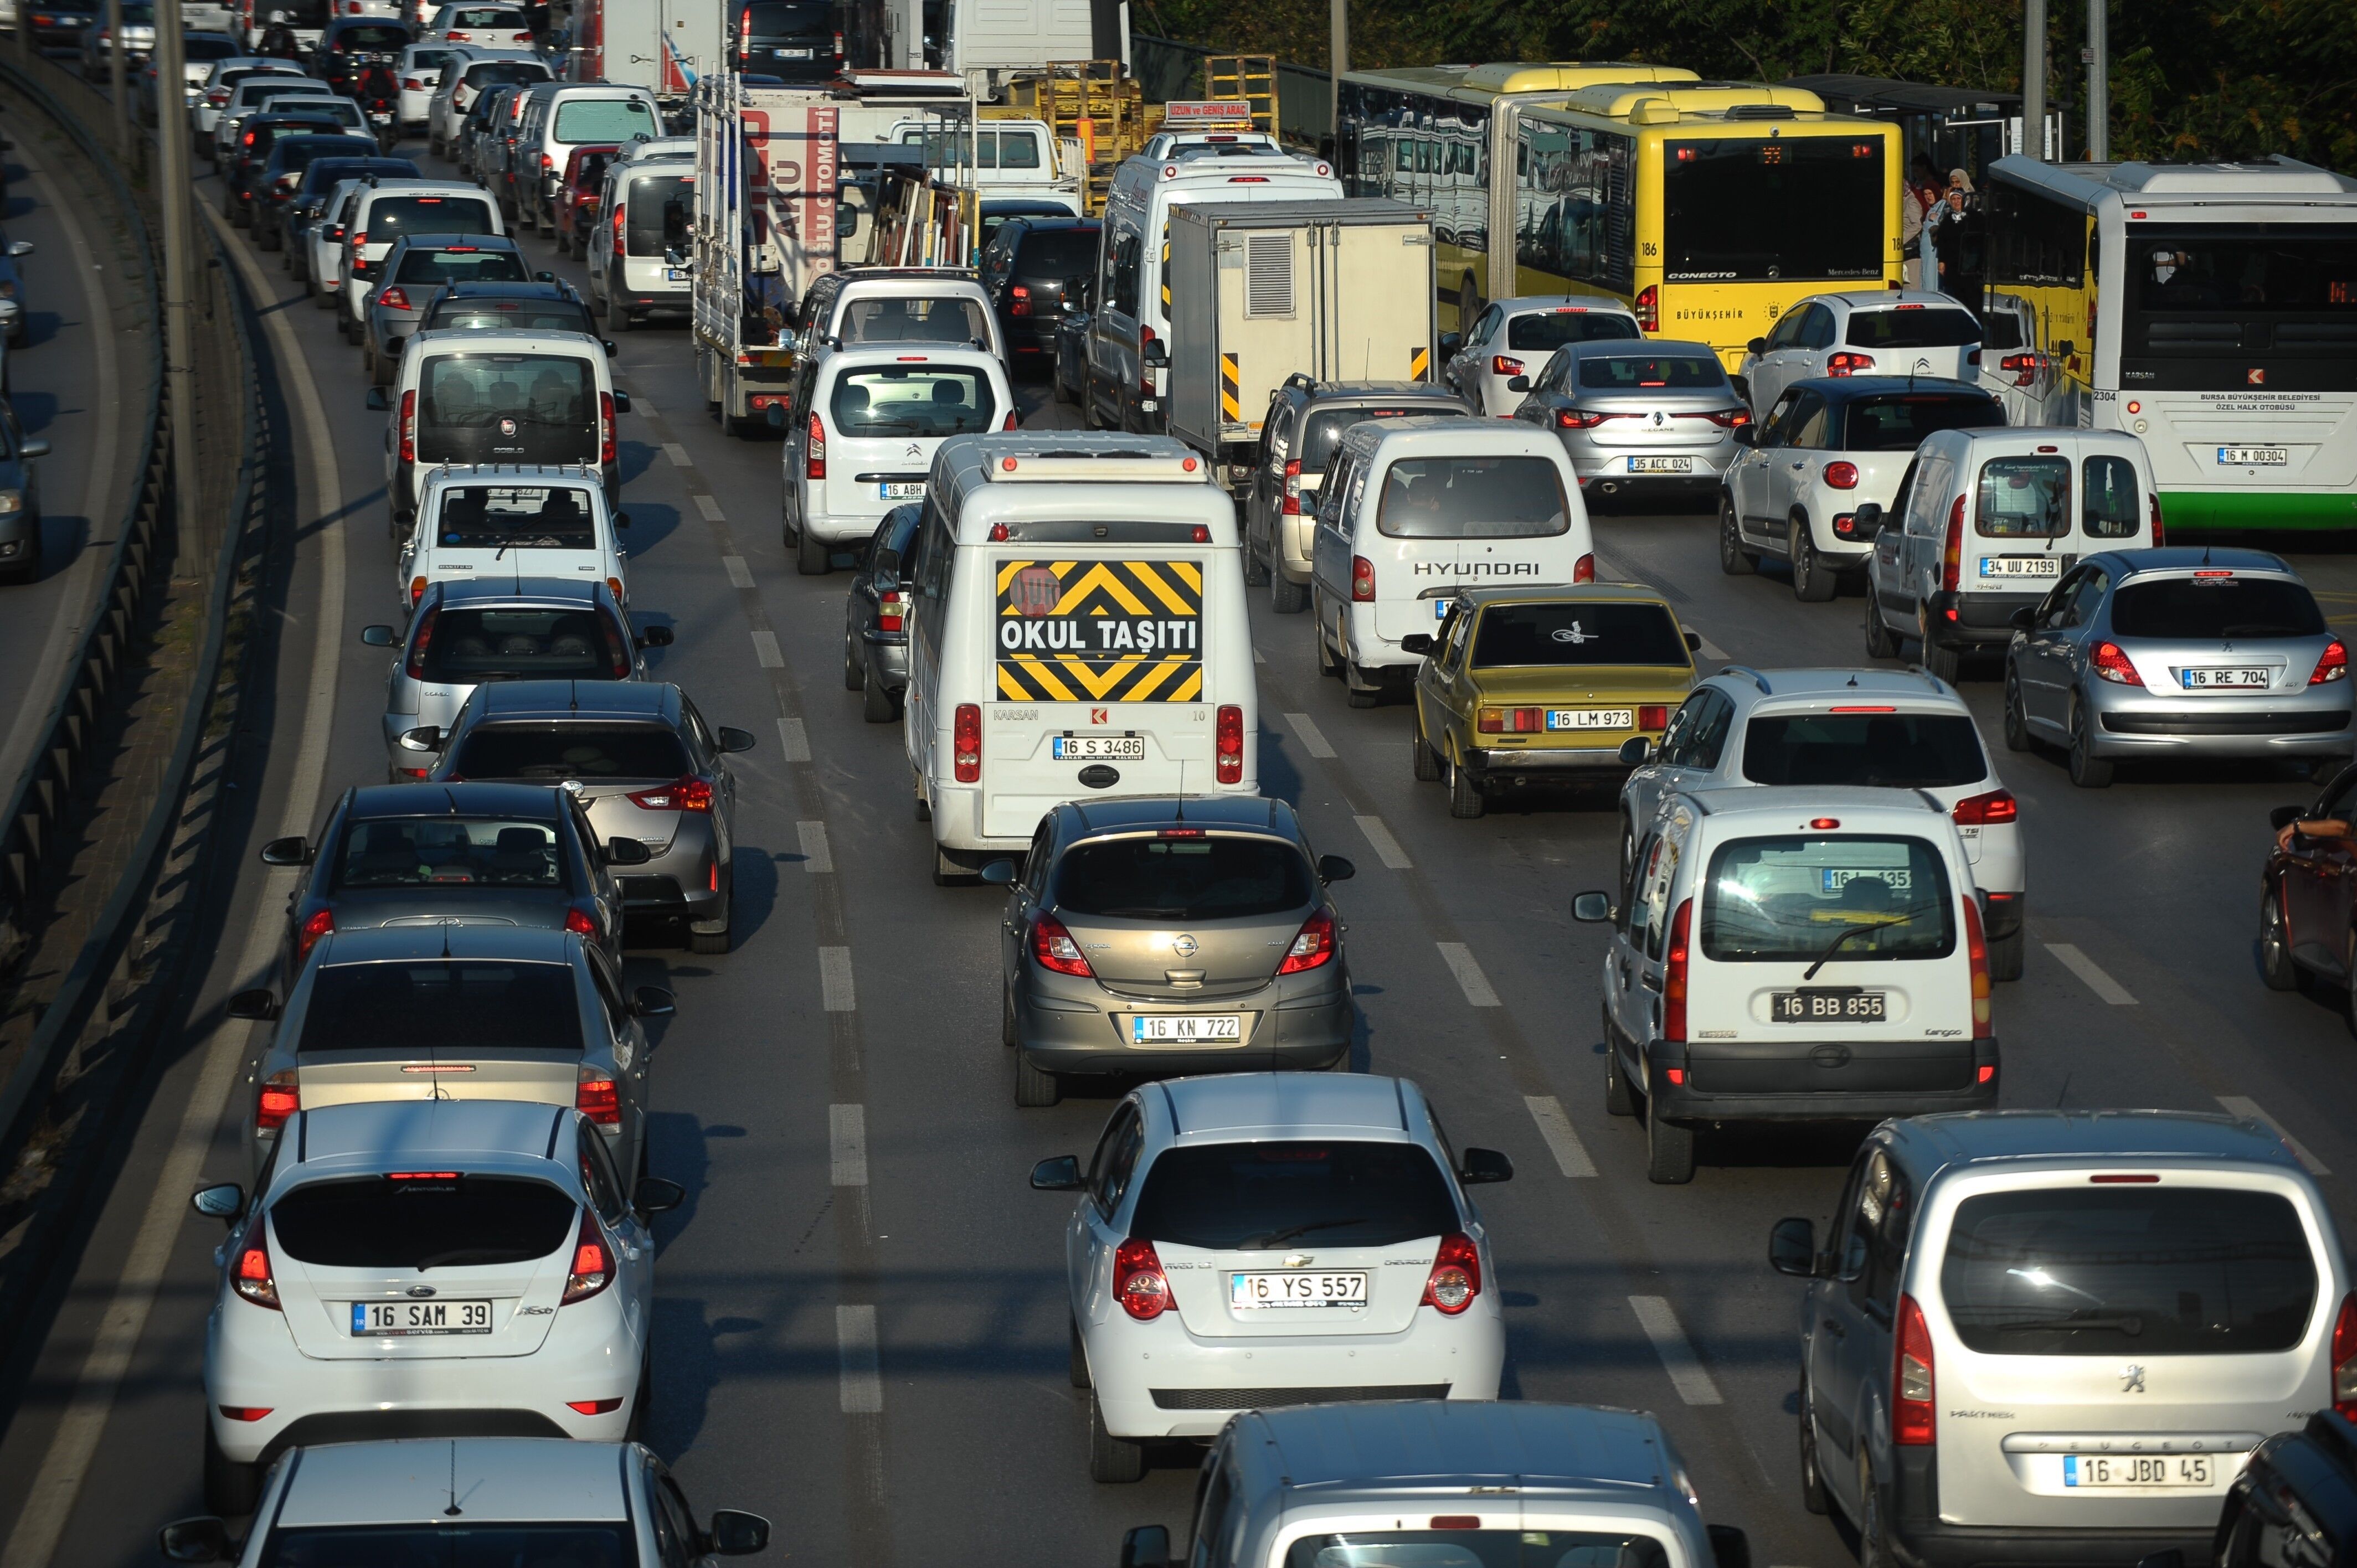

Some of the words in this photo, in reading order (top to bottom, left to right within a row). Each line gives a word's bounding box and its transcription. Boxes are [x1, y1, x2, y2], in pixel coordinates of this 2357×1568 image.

[1171, 106, 1191, 115] UZUN
[1202, 104, 1224, 116] GENİŞ
[1226, 105, 1246, 116] ARAÇ
[815, 107, 833, 208] OTOMOTİ
[771, 161, 801, 241] AKÜ
[1641, 243, 1657, 256] 186
[1676, 308, 1743, 321] BÜYÜKŞEHİR
[2093, 391, 2116, 401] 2304
[2227, 393, 2276, 401] BÜYÜKŞEHİR
[2226, 450, 2236, 461] 16
[2253, 450, 2283, 461] 00304
[1634, 459, 1646, 468] 35
[1651, 459, 1668, 468] ACC
[1672, 459, 1690, 468] 024
[888, 484, 898, 495] 16
[904, 484, 922, 495] ABH
[1414, 563, 1539, 575] HYUNDAI
[1988, 561, 2002, 572] 34
[2008, 561, 2021, 572] UU
[2026, 561, 2054, 572] 2199
[1001, 620, 1086, 649] OKUL
[1097, 620, 1196, 653] TAŞITI
[2193, 672, 2206, 684] 16
[2215, 672, 2234, 683] RE
[2242, 672, 2266, 683] 704
[994, 709, 1038, 721] KARSAN
[1556, 713, 1570, 726] 16
[1578, 713, 1598, 725] LM
[1604, 712, 1630, 725] 973
[1063, 740, 1078, 754] 16
[1086, 740, 1097, 754] S
[1104, 740, 1141, 754] 3486
[1782, 998, 1804, 1016] 16
[1812, 998, 1841, 1016] BB
[1846, 997, 1883, 1015] 855
[1150, 1020, 1166, 1036] 16
[1177, 1019, 1196, 1036] KN
[1207, 1019, 1236, 1035] 722
[1925, 1029, 1963, 1037] Kangoo
[1247, 1278, 1269, 1298] 16
[1282, 1278, 1312, 1297] YS
[1322, 1277, 1362, 1297] 557
[372, 1305, 395, 1327] 16
[409, 1304, 446, 1326] SAM
[461, 1304, 486, 1325] 39
[2086, 1459, 2109, 1482] 16
[2126, 1459, 2165, 1482] JBD
[2181, 1459, 2206, 1482] 45
